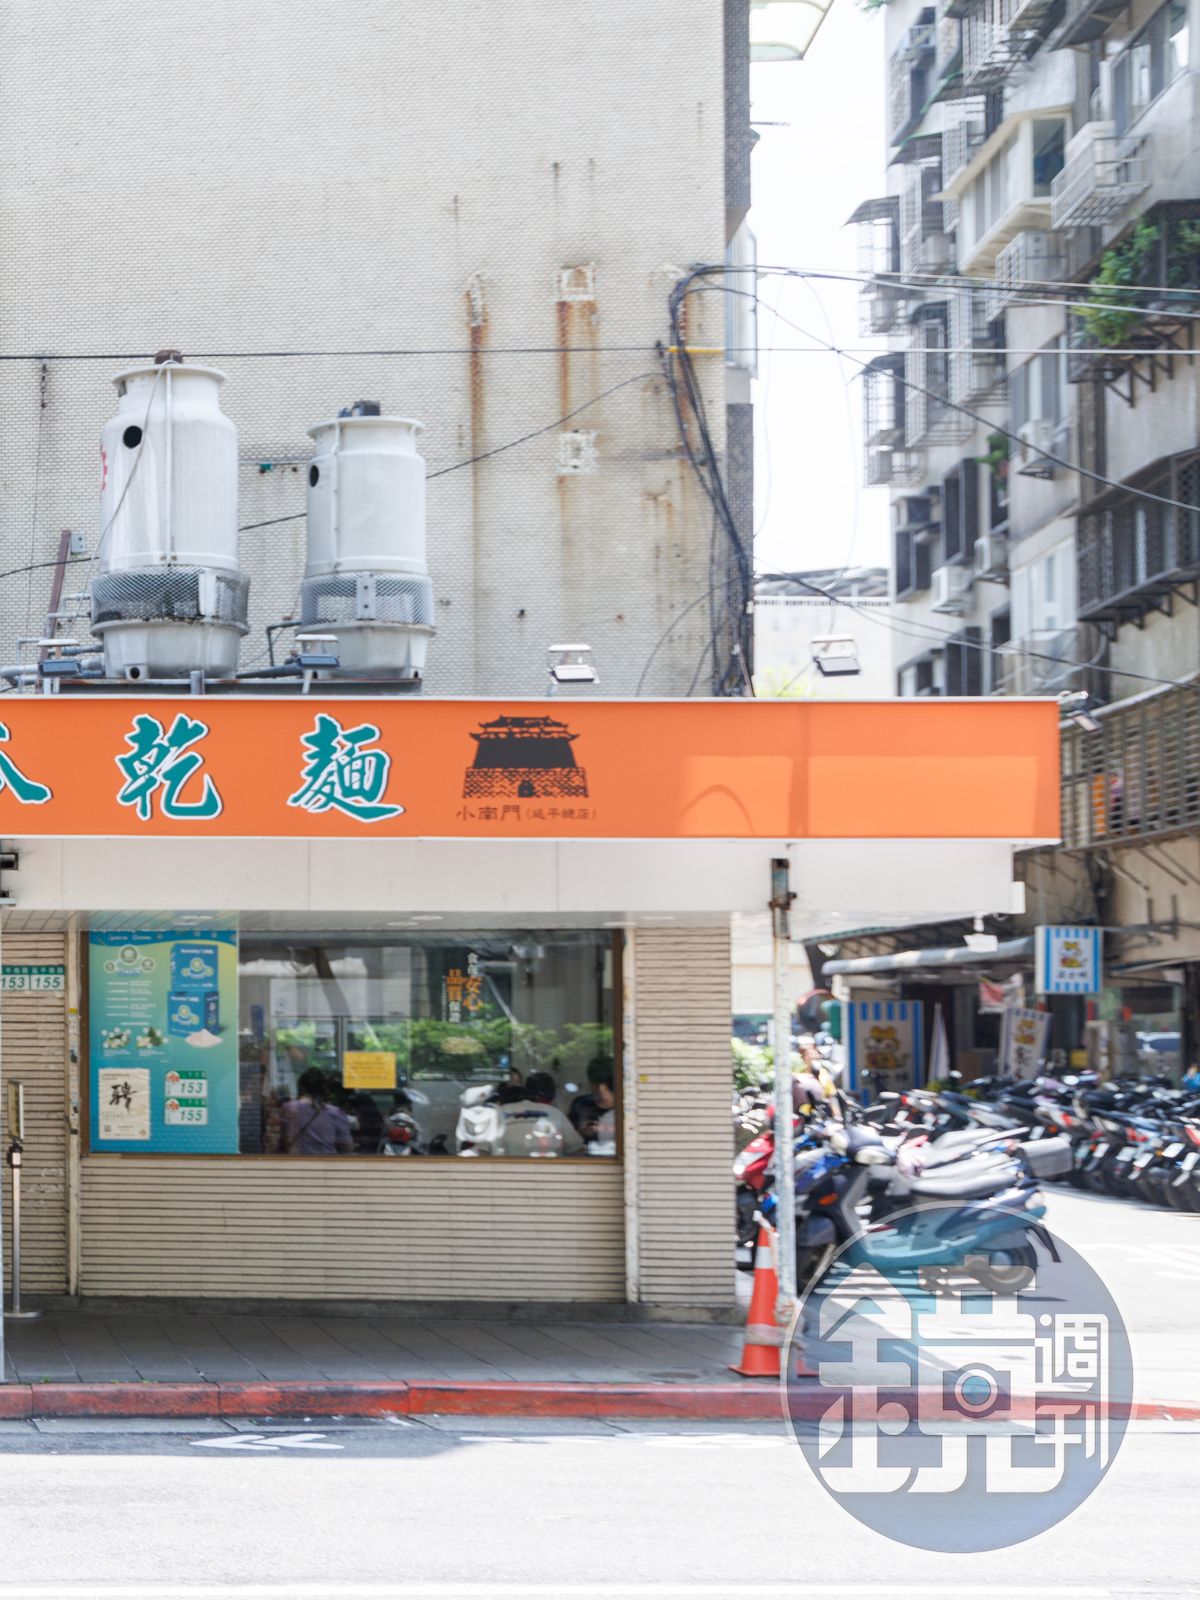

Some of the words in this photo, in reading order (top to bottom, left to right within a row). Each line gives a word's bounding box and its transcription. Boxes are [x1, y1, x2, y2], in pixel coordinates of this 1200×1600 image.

[1, 976, 25, 989] 153
[36, 976, 61, 989] 155
[180, 1082, 204, 1094] 153
[180, 1109, 204, 1122] 155
